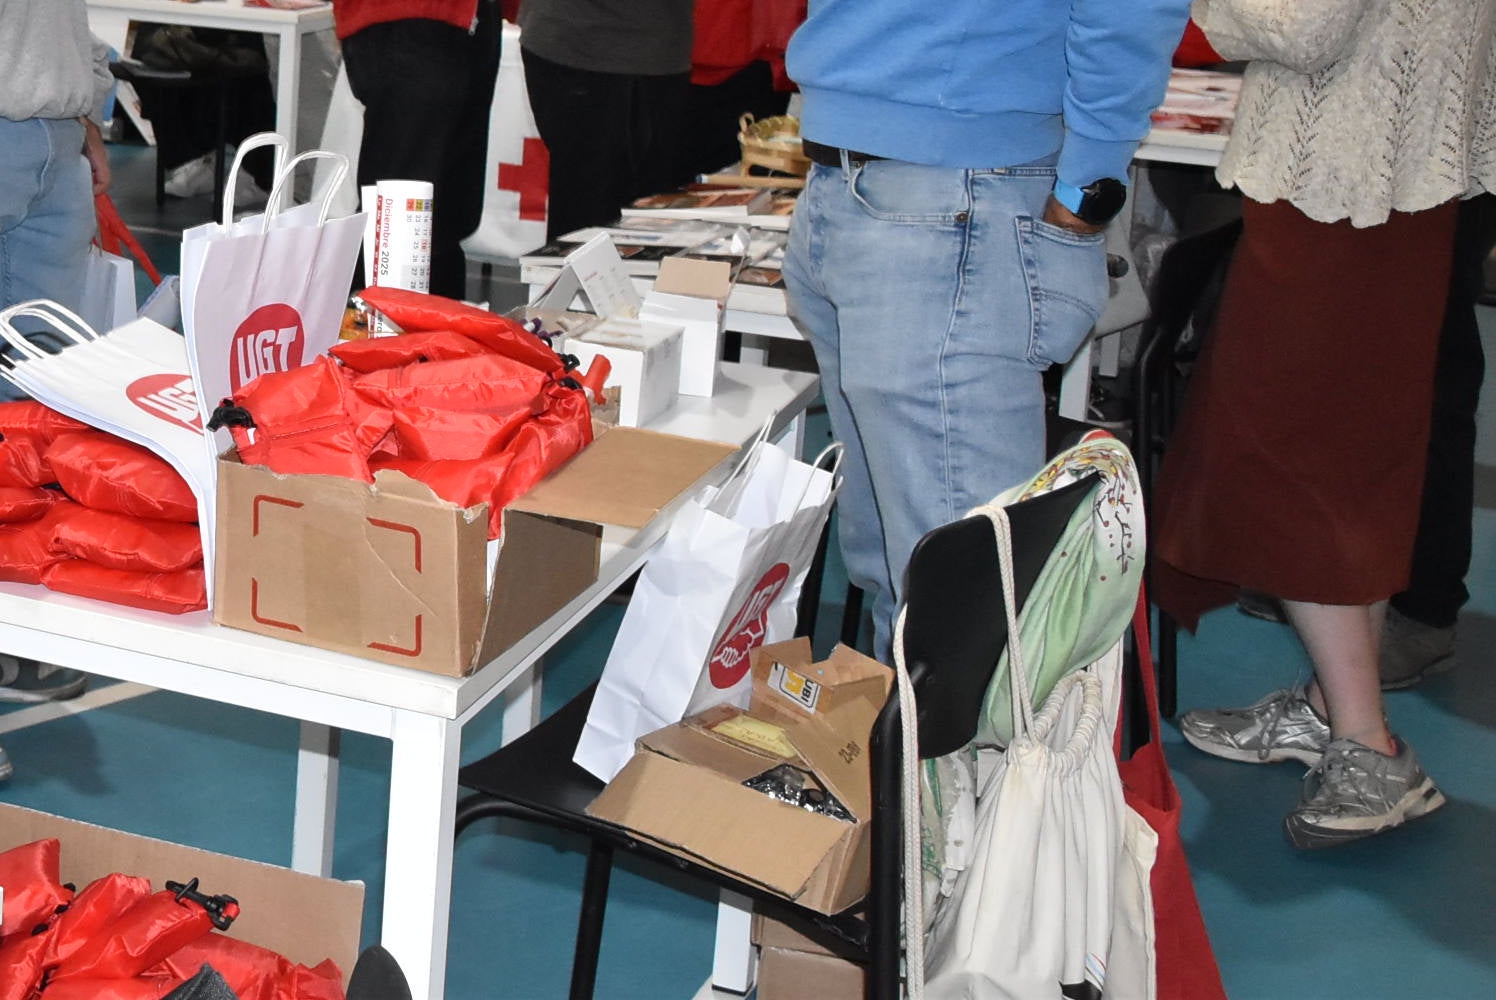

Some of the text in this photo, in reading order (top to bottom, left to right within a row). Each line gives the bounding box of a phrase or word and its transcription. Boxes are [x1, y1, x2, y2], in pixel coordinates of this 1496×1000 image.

[380, 198, 393, 276] Diciembre 2025
[237, 325, 298, 388] UGT
